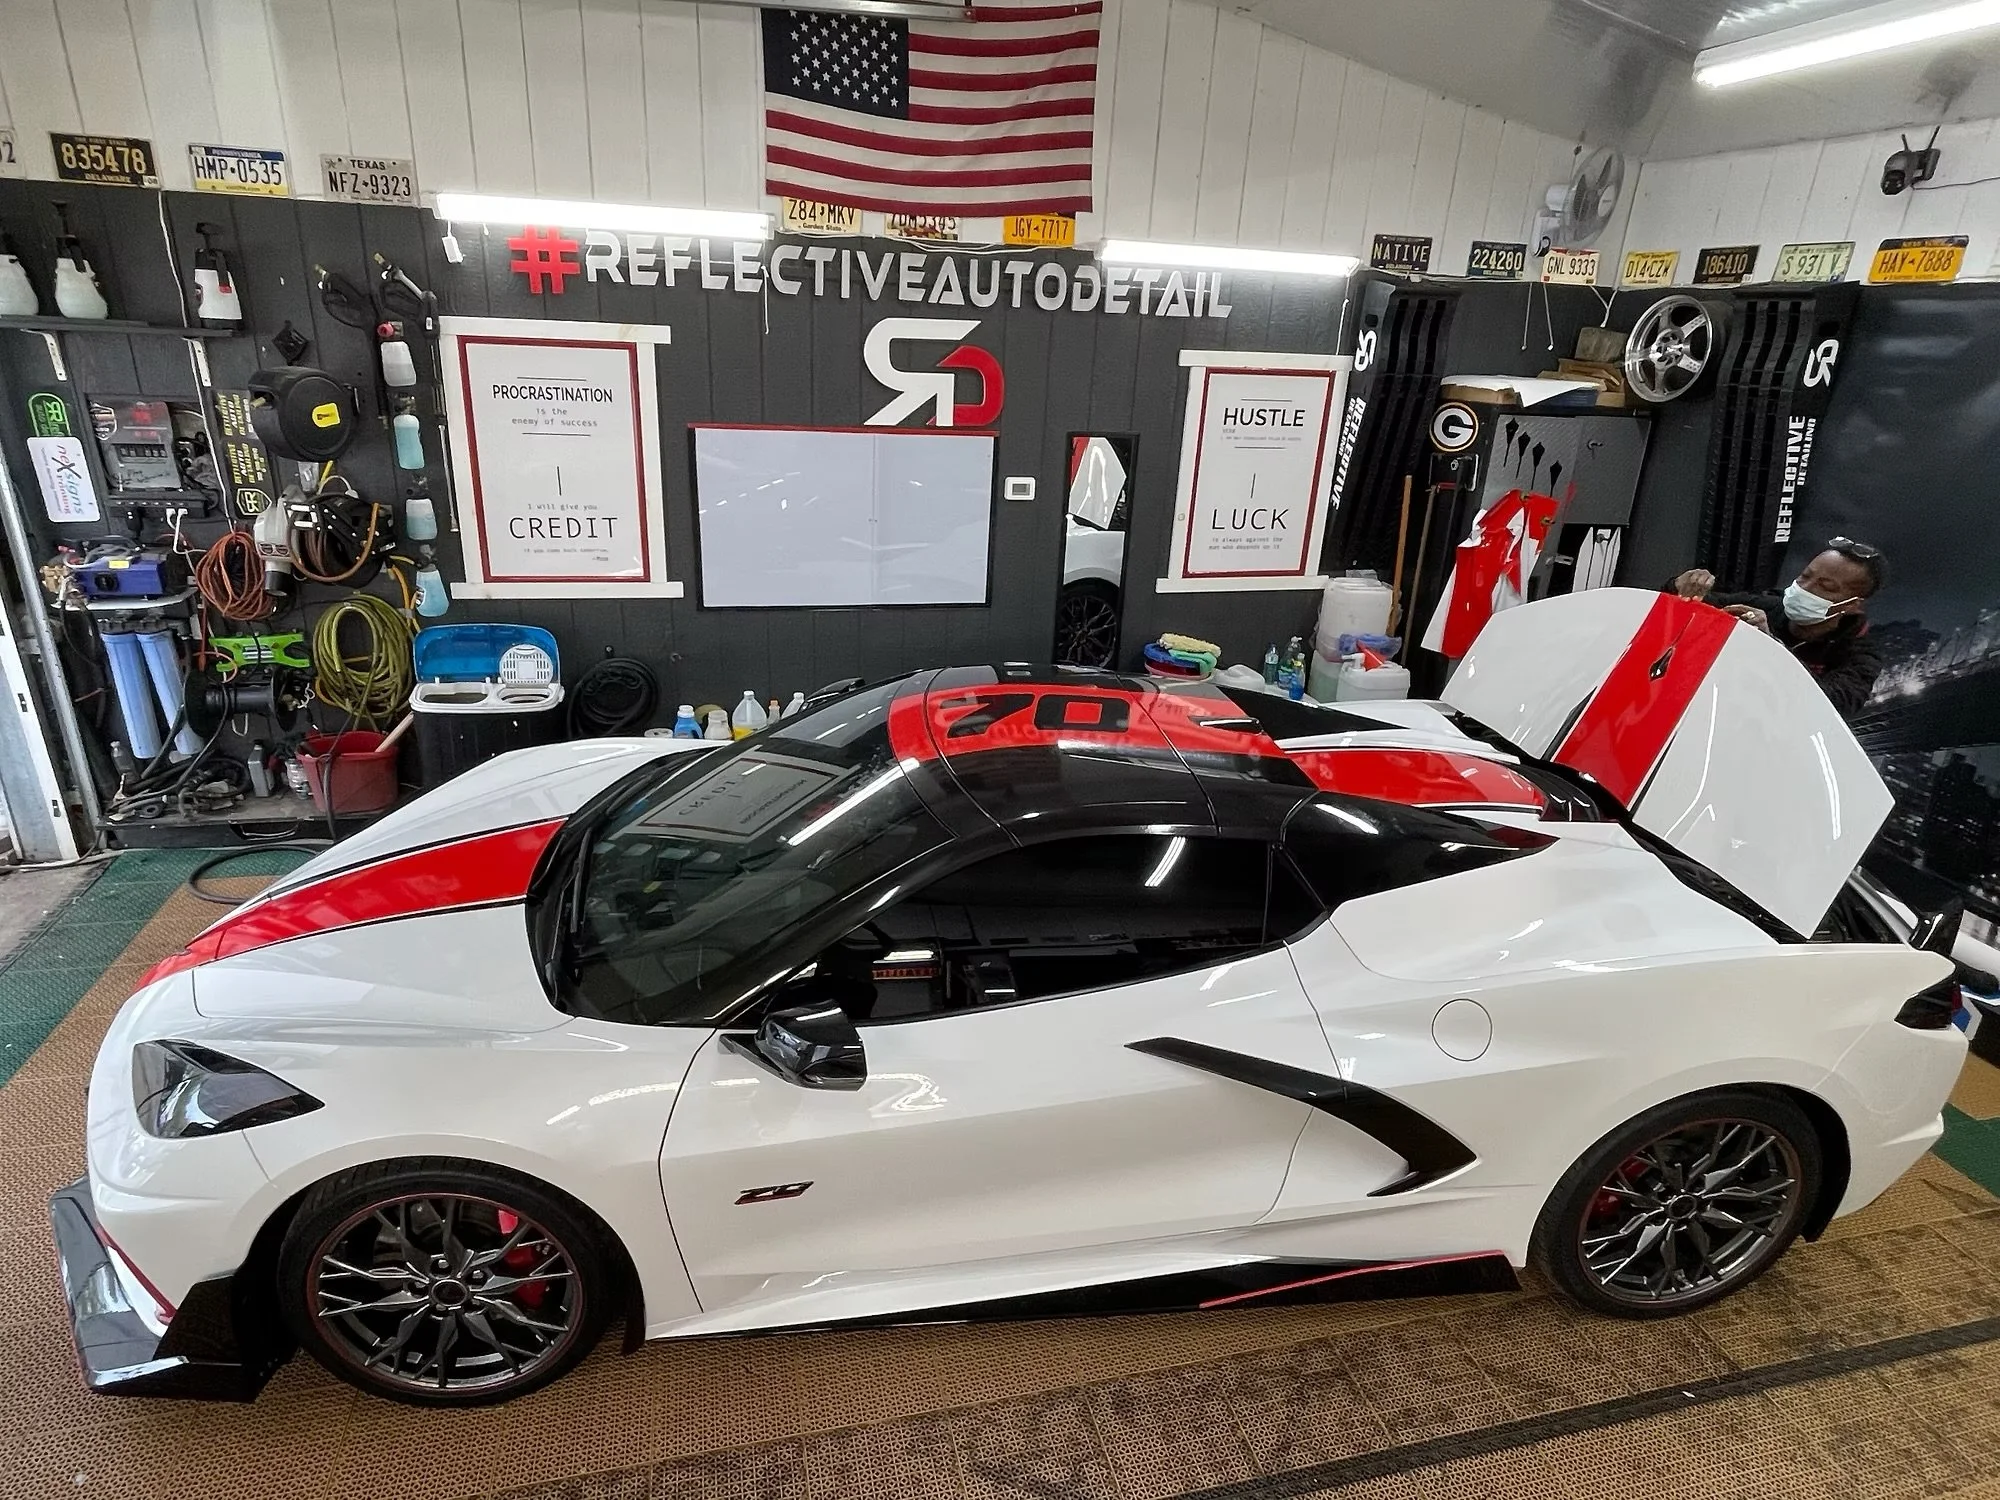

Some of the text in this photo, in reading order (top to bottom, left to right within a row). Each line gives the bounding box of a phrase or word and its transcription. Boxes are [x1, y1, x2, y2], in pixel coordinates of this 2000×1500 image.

[61, 142, 147, 175] 835478
[350, 160, 386, 171] TEXAS
[802, 222, 842, 232] Garden State
[1373, 243, 1430, 263] NATIVE
[1471, 248, 1523, 271] 224280
[1702, 253, 1748, 275] 186410
[492, 384, 613, 402] PROCRASTINATION
[511, 418, 598, 427] enemy of success
[1223, 407, 1306, 427] HUSTLE
[1330, 396, 1367, 511] REFLECTIVE
[1774, 415, 1806, 543] REFLECTIVE
[509, 517, 618, 539] CREDIT
[1212, 508, 1289, 530] LUCK
